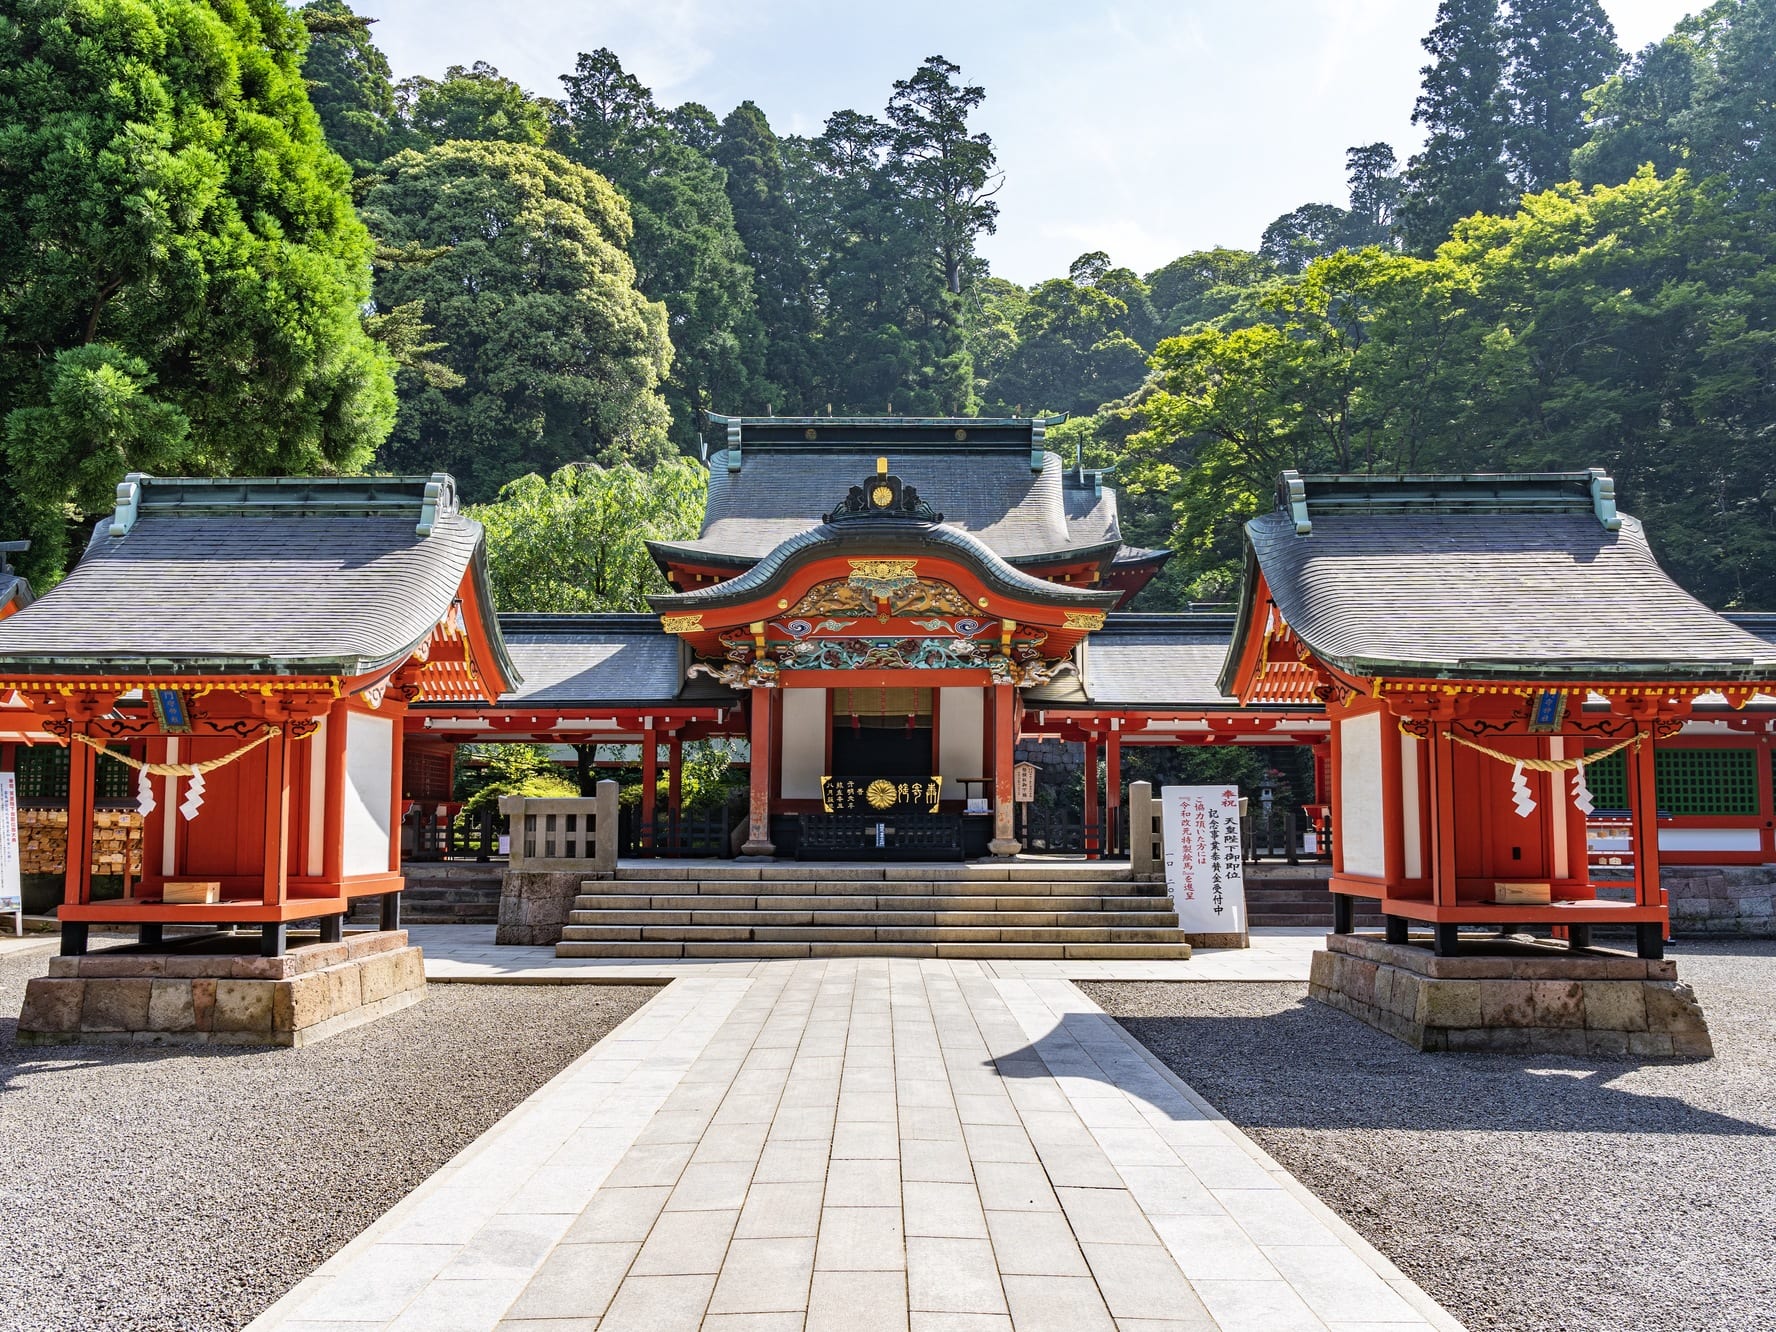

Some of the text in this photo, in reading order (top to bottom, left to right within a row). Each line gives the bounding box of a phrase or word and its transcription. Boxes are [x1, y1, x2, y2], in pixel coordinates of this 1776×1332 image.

[1194, 796, 1207, 865] ご協力頂いた方には
[1208, 808, 1224, 917] 記念事業奉賛金受付中
[1221, 789, 1241, 880] 奉祝 天皇陛下御即位
